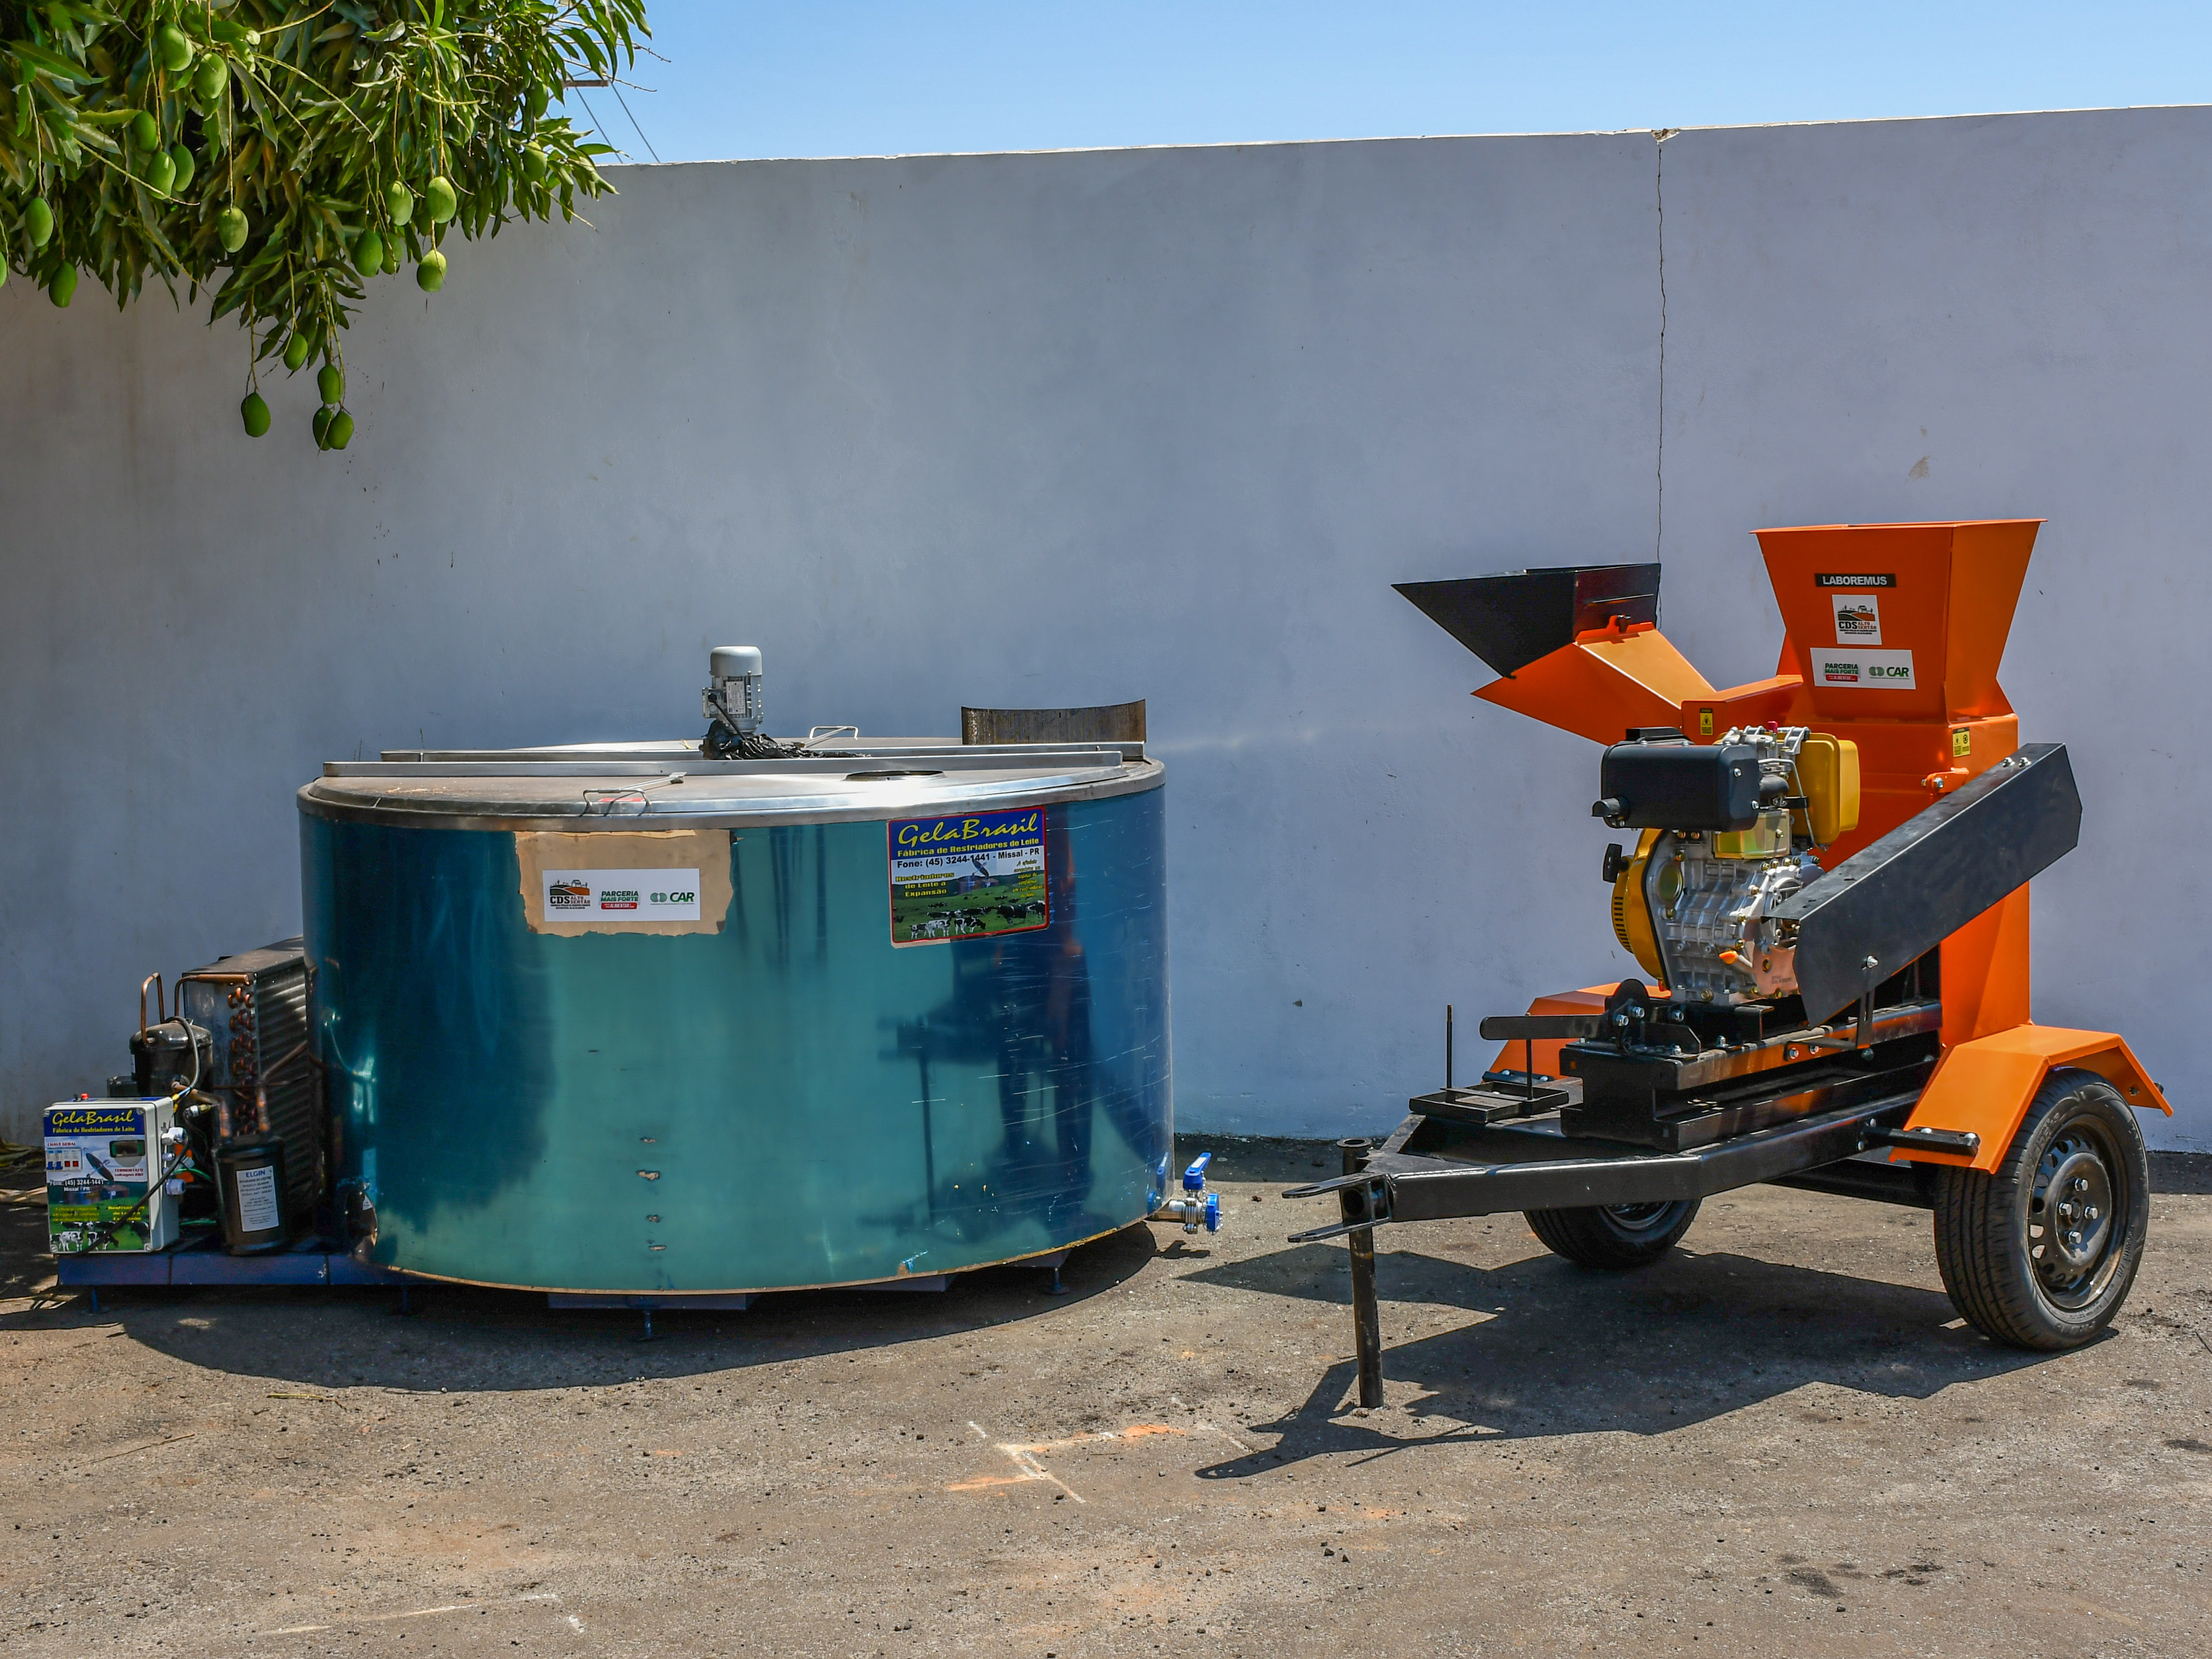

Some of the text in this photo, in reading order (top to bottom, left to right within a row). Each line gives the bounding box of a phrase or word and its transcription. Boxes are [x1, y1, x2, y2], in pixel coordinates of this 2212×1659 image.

[1822, 575, 1887, 586] LABOREMUS
[1838, 621, 1858, 629] CDS
[1886, 666, 1909, 677] CAR
[898, 812, 1038, 848] GelaBrasil
[897, 849, 934, 857] Fábrica
[950, 842, 1008, 853] Resfriadores
[897, 860, 923, 869] Fone:
[925, 857, 943, 868] (45)
[946, 853, 990, 865] 3244-1441
[998, 849, 1023, 859] Missal
[1030, 848, 1039, 856] PR
[895, 872, 955, 882] Resfriadores
[670, 892, 695, 902] CAR
[905, 889, 947, 897] Expansão
[550, 896, 570, 904] CDS
[52, 1110, 134, 1127] GelaBrasil
[245, 1169, 265, 1178] ELGIN
